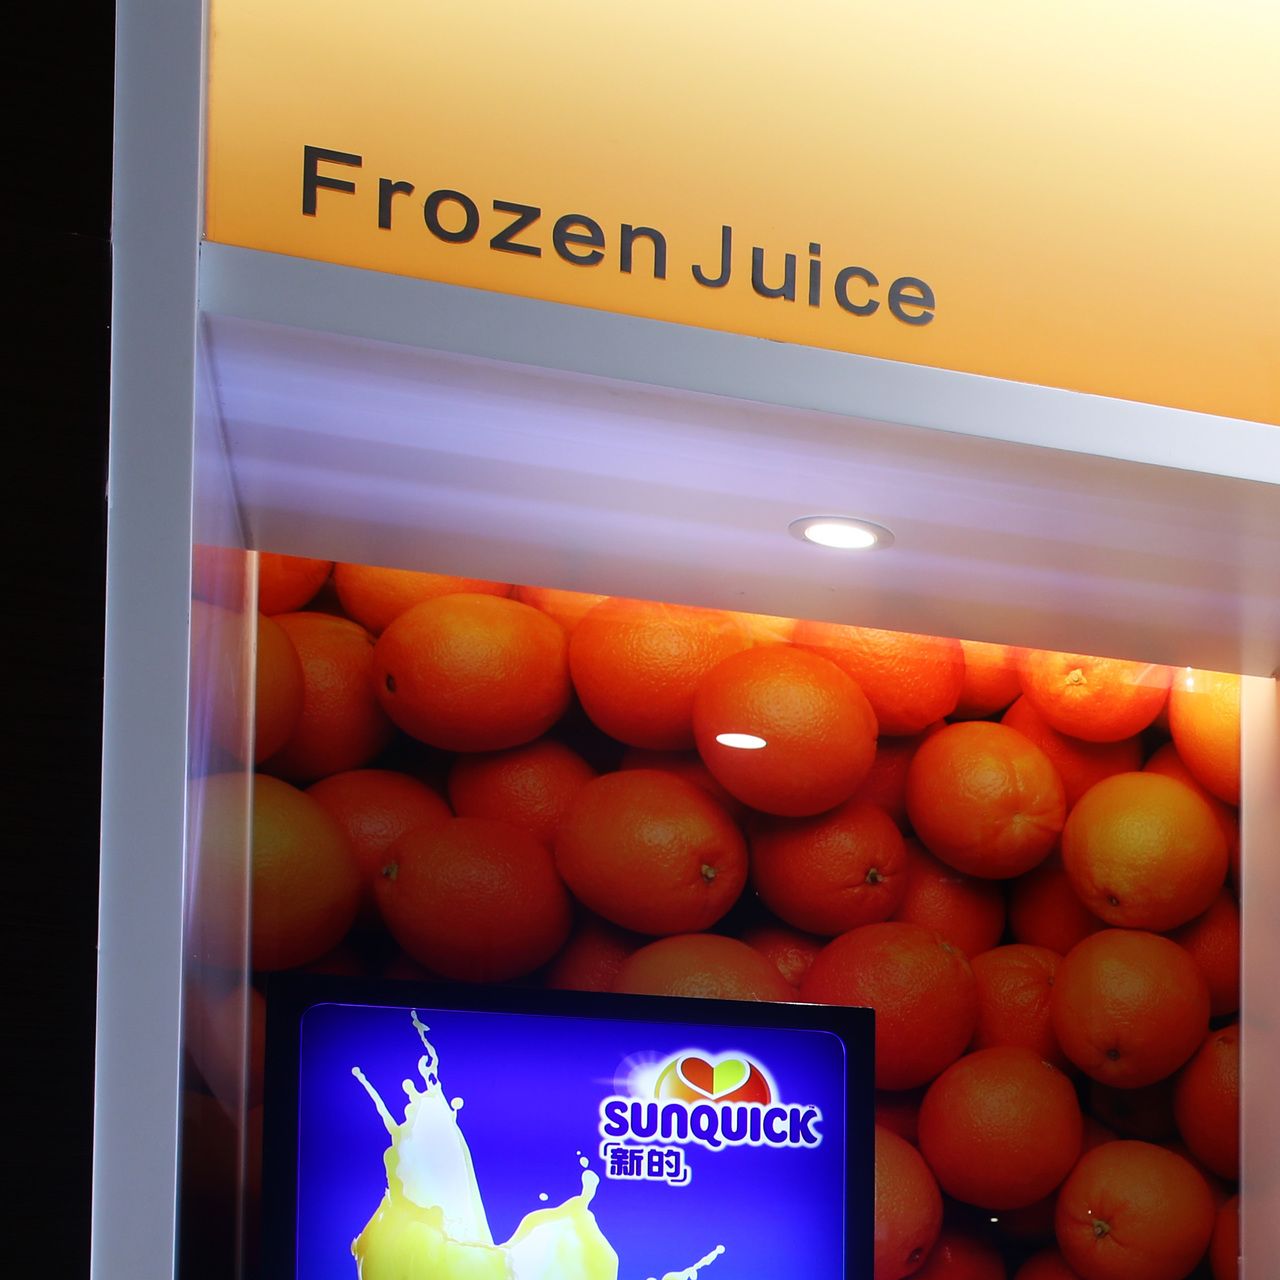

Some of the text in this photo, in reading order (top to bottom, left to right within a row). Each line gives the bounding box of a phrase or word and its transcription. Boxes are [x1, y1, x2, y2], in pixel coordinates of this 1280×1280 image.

[302, 145, 936, 326] Frozen Juice
[604, 1101, 818, 1147] SUNQUICK
